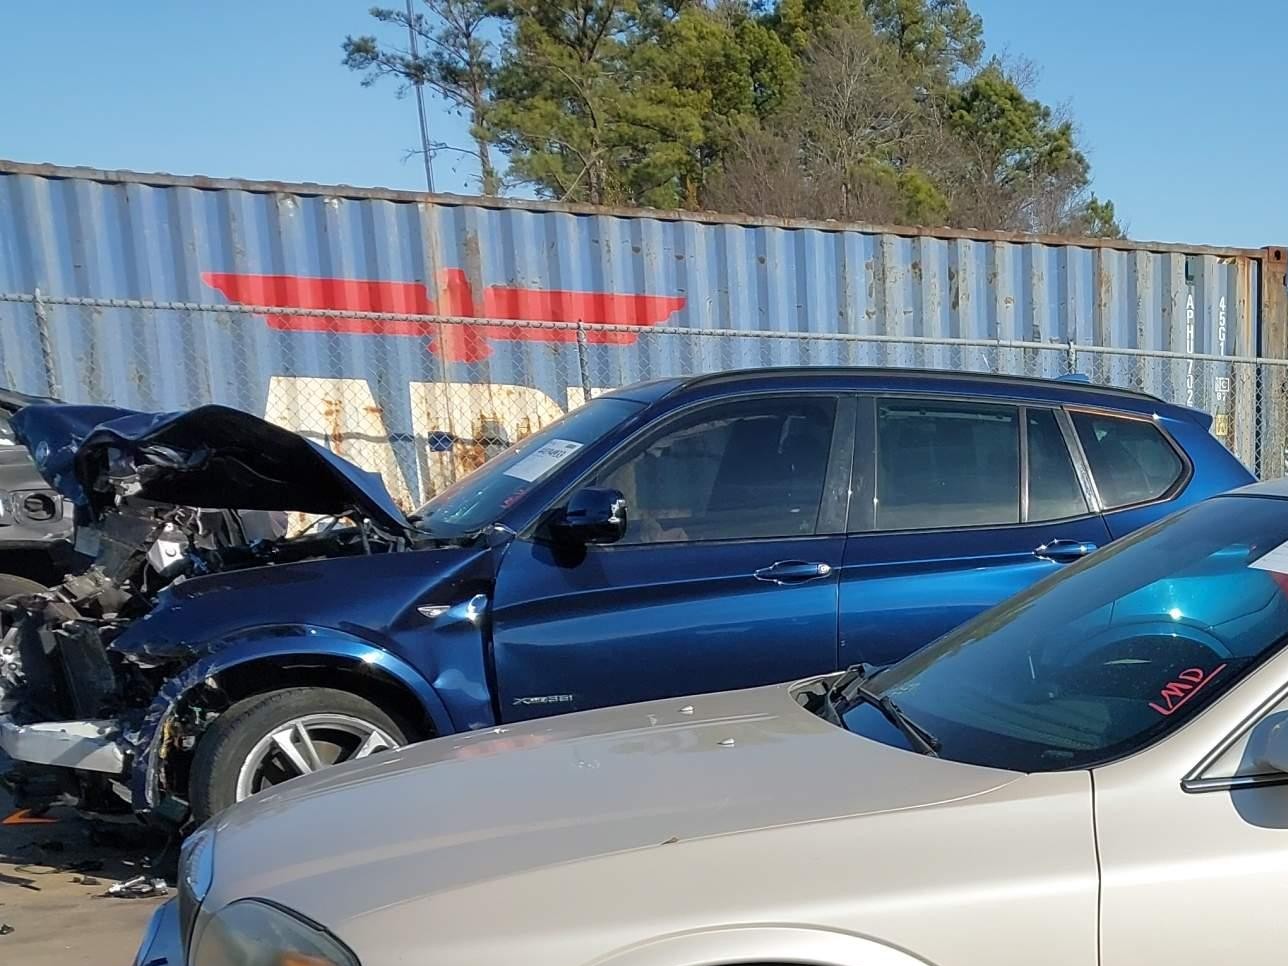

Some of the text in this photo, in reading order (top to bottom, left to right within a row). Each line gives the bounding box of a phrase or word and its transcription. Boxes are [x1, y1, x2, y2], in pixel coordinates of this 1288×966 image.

[1185, 294, 1195, 407] APHU 702
[1218, 296, 1227, 357] 45G1
